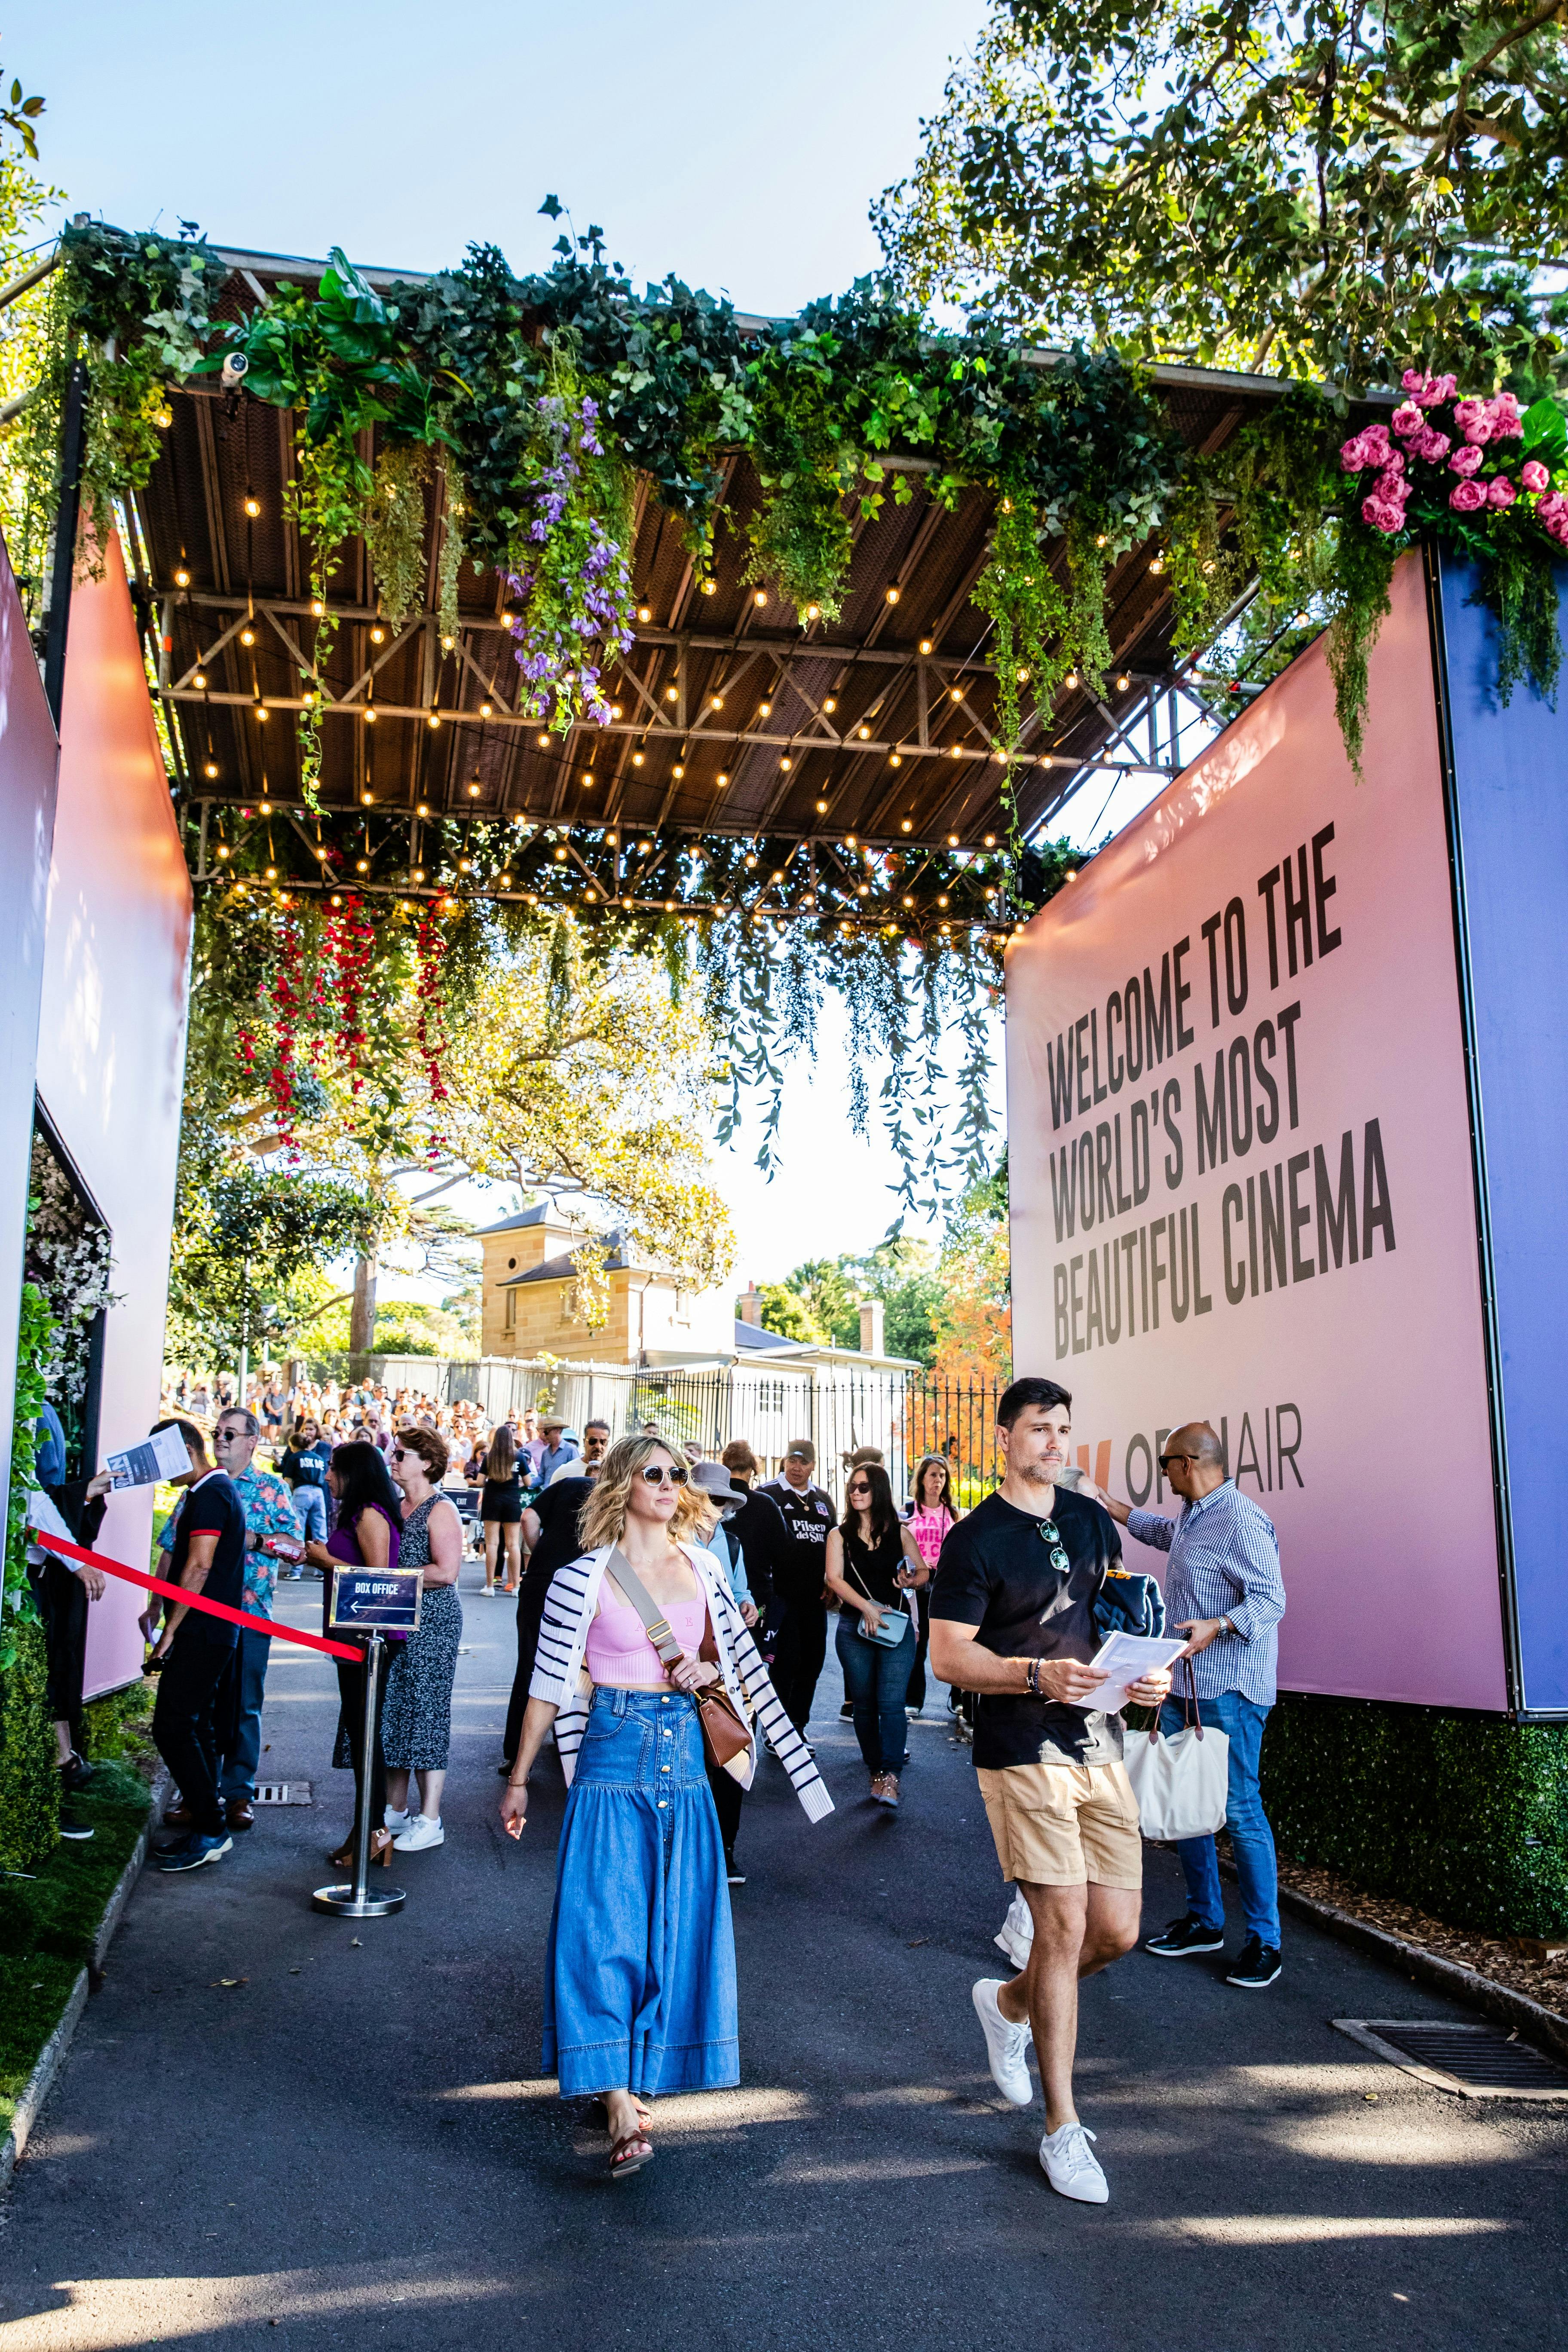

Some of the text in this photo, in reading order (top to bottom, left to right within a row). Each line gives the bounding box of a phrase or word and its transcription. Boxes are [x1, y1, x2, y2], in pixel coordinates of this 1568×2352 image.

[1047, 821, 1342, 1131] WELCOME TO THE
[1050, 1000, 1301, 1243] WORLD'S MOST
[1054, 1118, 1396, 1360] BEAUTIFUL CINEMA
[110, 1456, 129, 1487] OPN
[300, 1458, 325, 1471] ASK ME
[511, 1462, 520, 1472] E
[792, 1520, 826, 1532] Pilsen
[809, 1532, 824, 1543] Sur
[916, 1528, 948, 1543] MIL
[355, 1583, 398, 1595] BOX OFFICE
